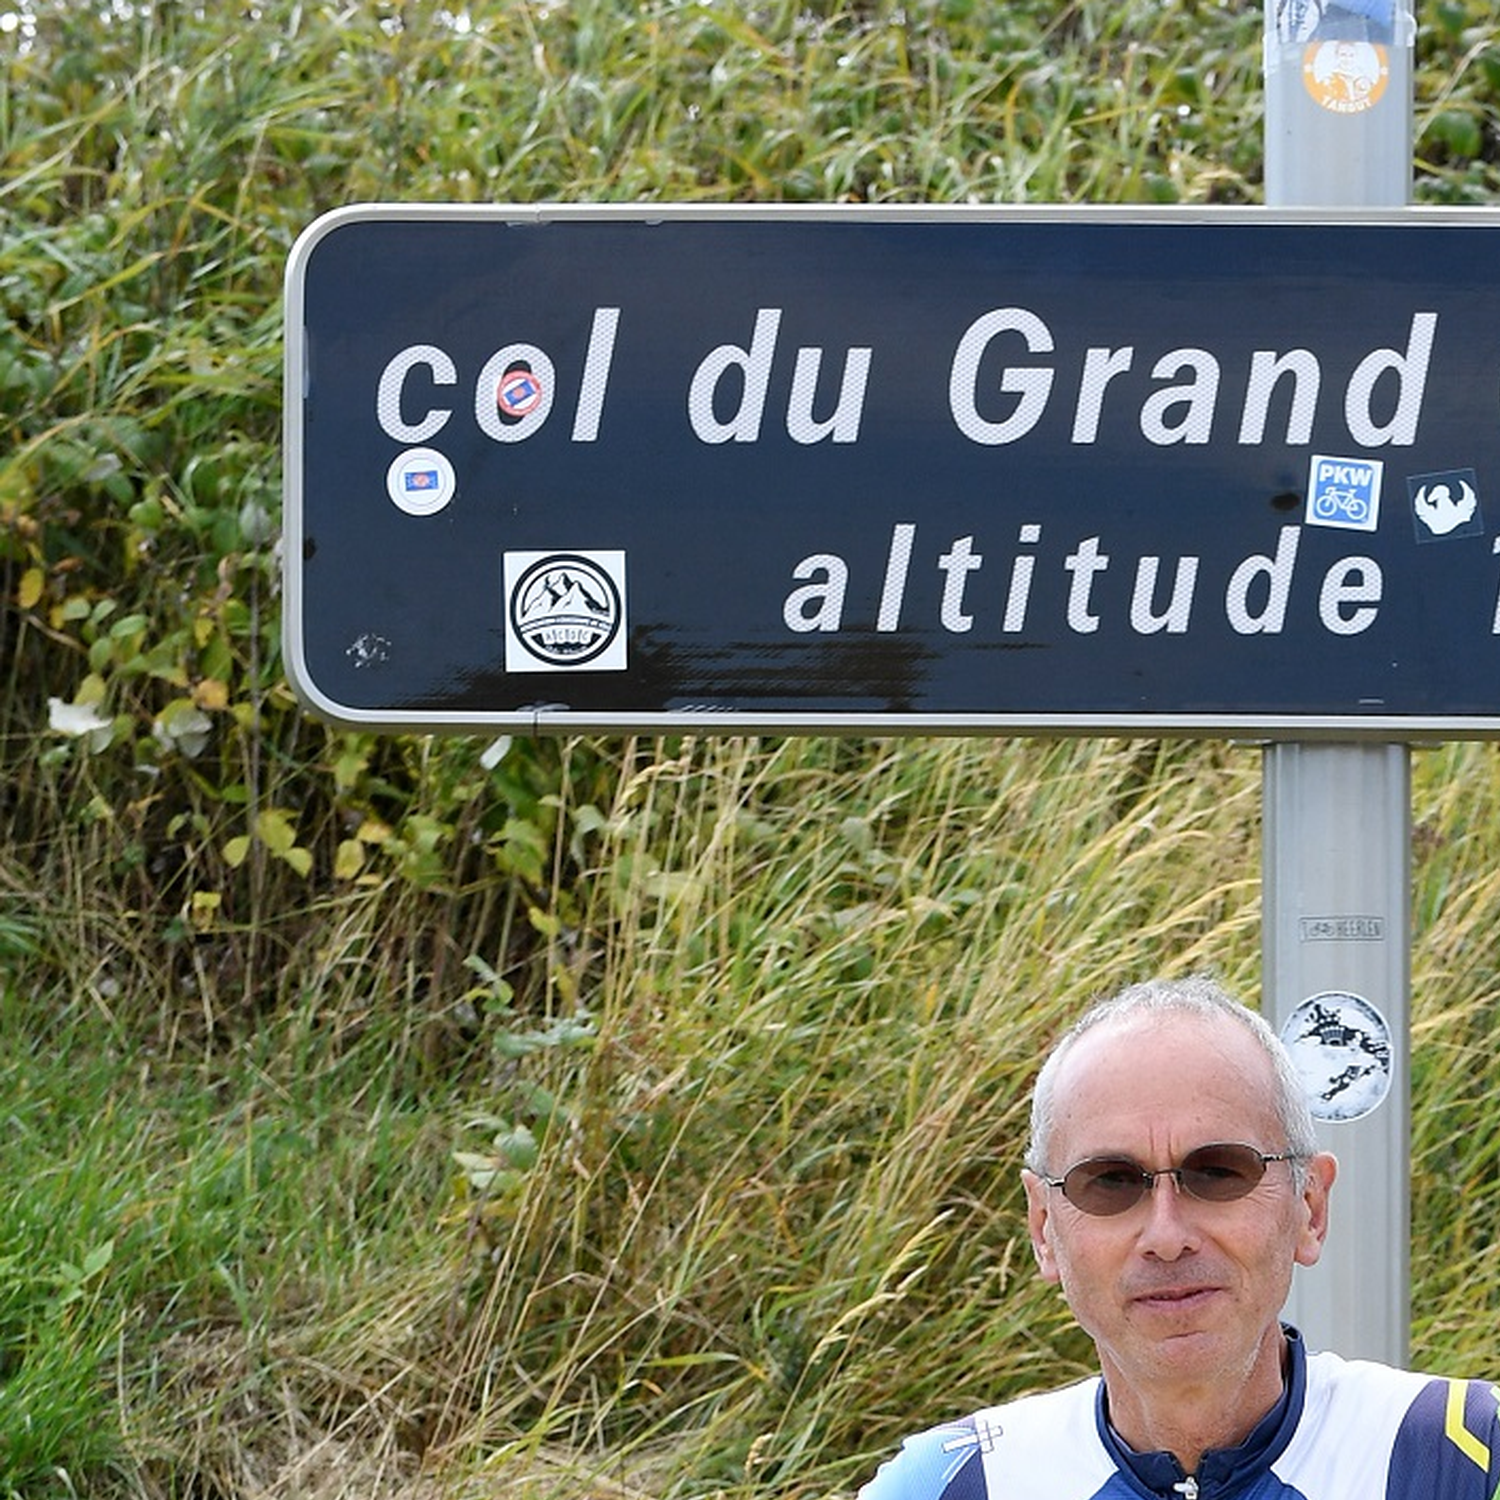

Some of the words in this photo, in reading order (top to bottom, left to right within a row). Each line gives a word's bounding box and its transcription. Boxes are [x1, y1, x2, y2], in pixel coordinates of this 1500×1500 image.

[377, 307, 621, 444] col
[688, 308, 873, 444] du
[949, 307, 1438, 448] Grand
[1319, 463, 1373, 487] PKW
[783, 523, 1383, 635] altitude
